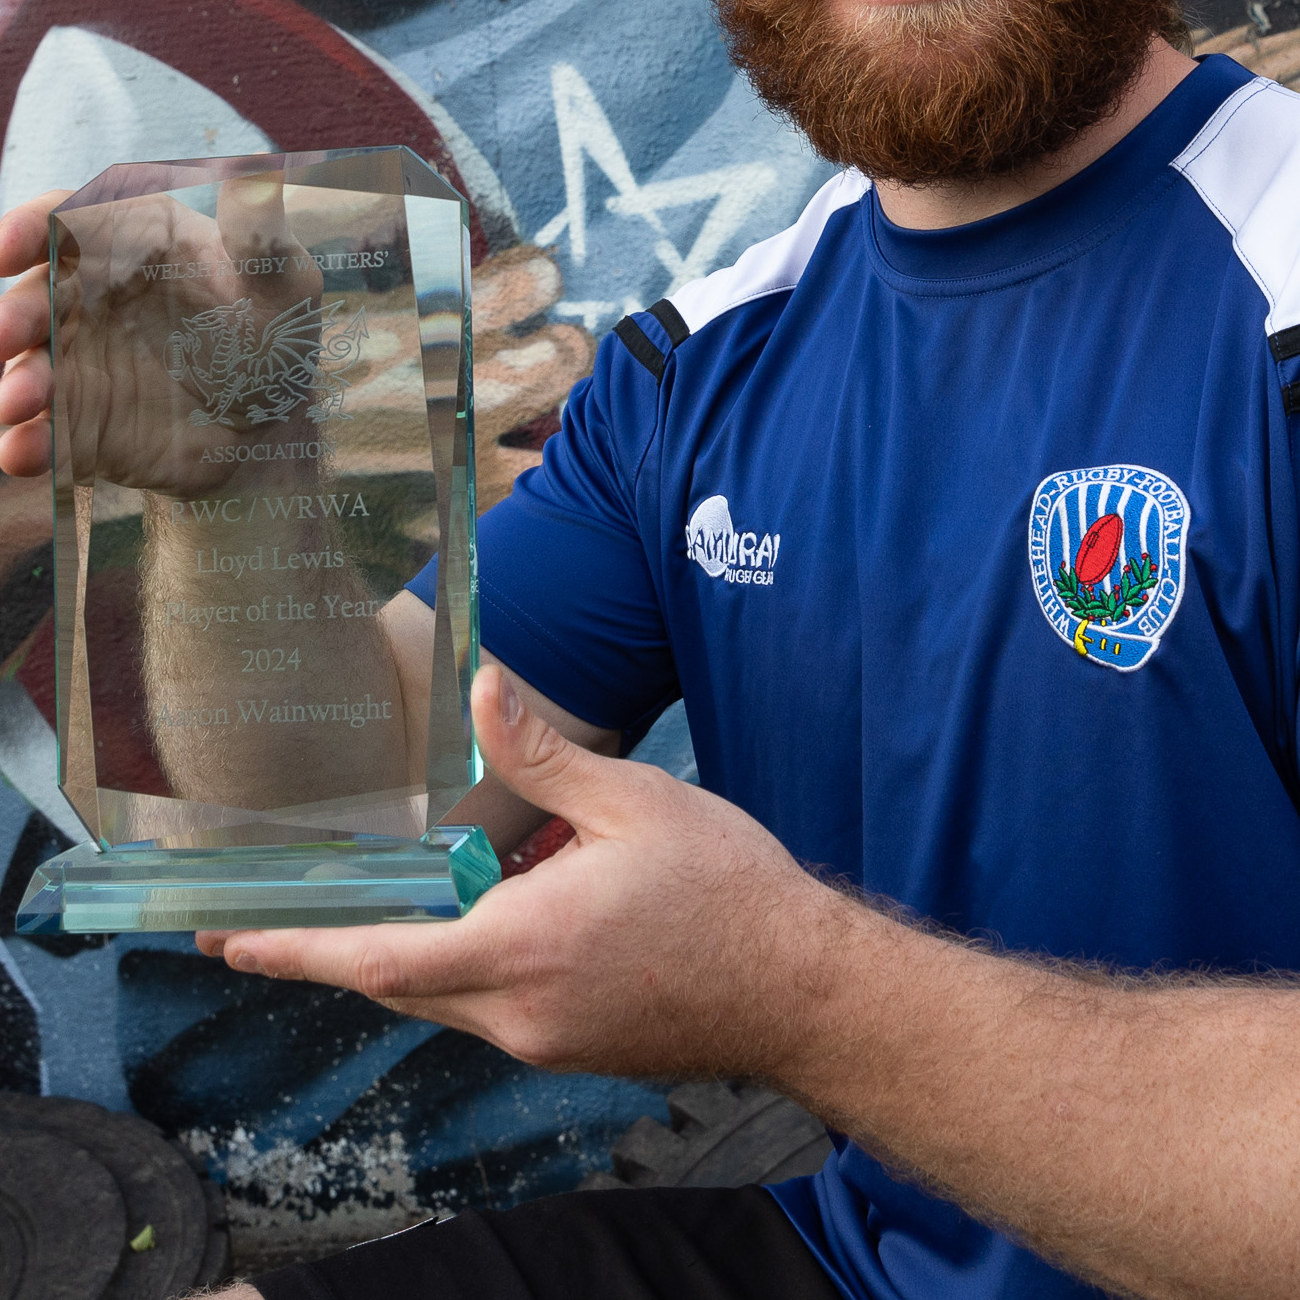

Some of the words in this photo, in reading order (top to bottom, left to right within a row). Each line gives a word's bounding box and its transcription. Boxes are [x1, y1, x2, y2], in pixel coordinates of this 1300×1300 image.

[141, 261, 214, 282] WELSH
[216, 256, 288, 276] RUGBY
[200, 441, 337, 464] ASSOCIATION
[170, 498, 242, 524] RWC
[262, 492, 371, 519] WRWA
[196, 545, 264, 580] Lloyd
[270, 545, 345, 571] Lewis
[164, 600, 241, 632] Player
[246, 594, 274, 622] of
[275, 594, 317, 621] the
[321, 595, 379, 619] Year
[241, 646, 302, 673] 2024
[156, 701, 231, 728] Aaron
[236, 693, 393, 729] Wainwright
